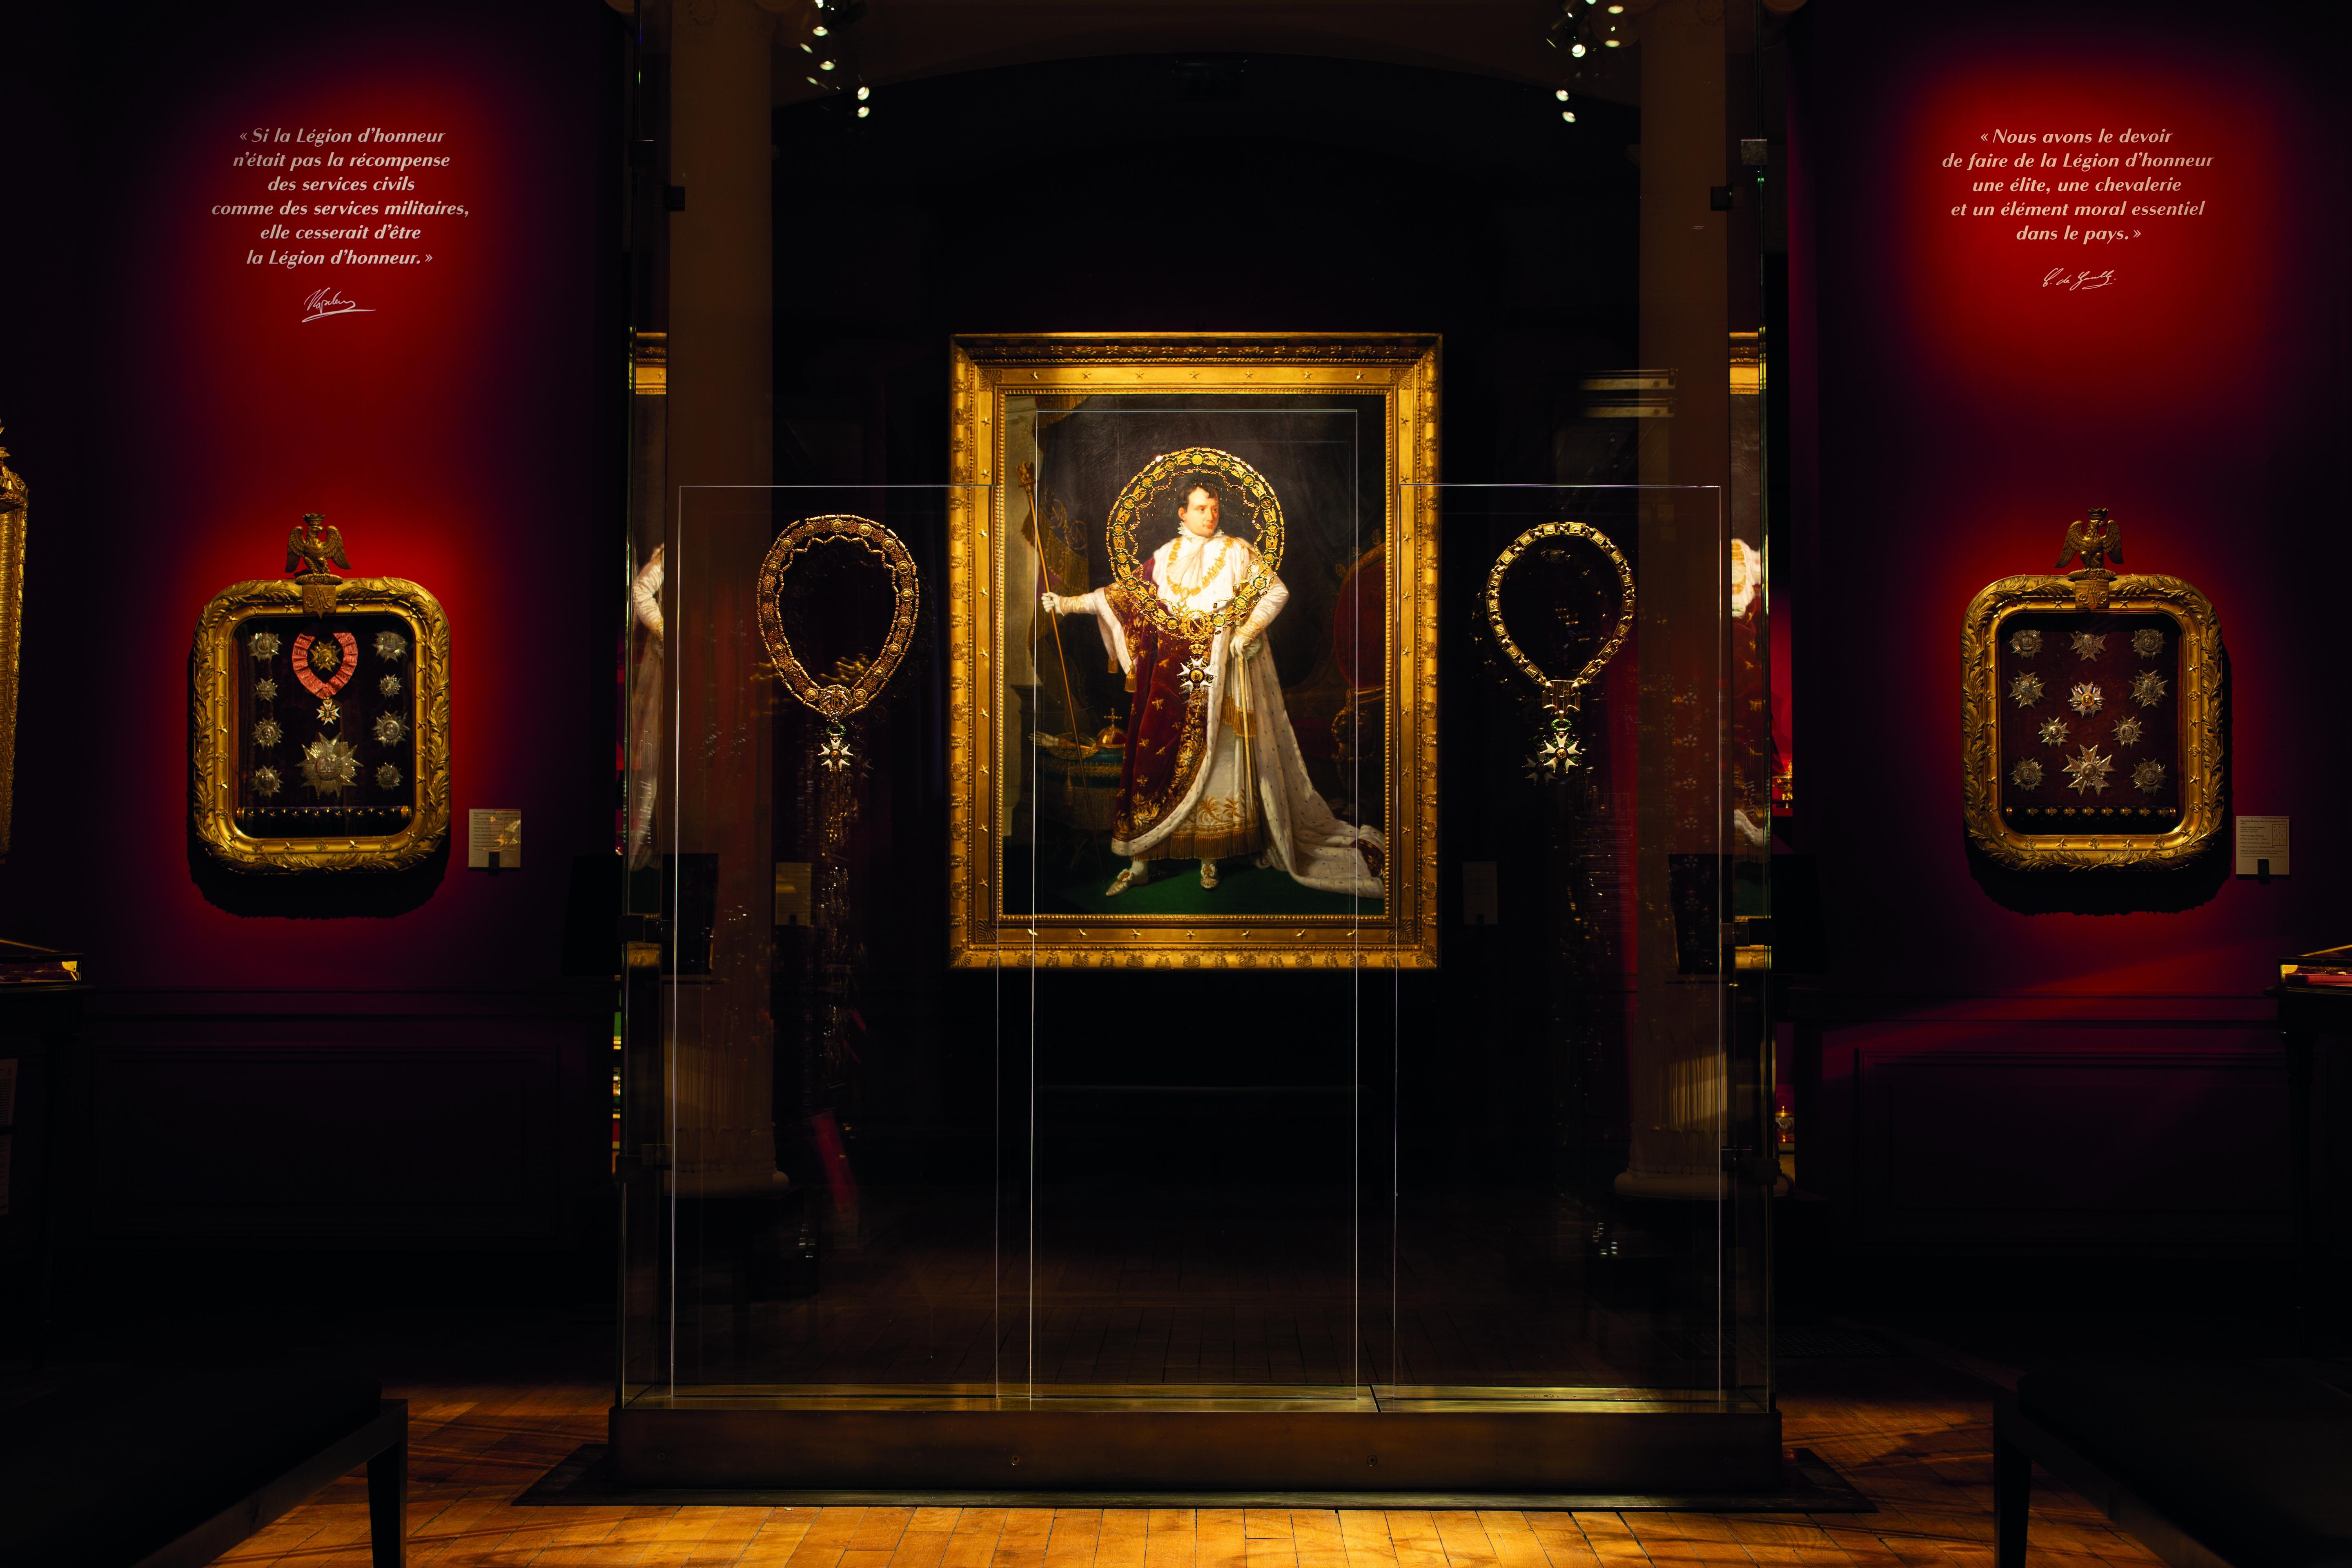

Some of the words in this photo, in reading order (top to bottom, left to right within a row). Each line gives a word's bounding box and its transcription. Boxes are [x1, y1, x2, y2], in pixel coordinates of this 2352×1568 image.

[252, 128, 270, 142] Si
[274, 128, 290, 142] la
[297, 129, 352, 147] Légion
[358, 127, 445, 142] d’honneur
[1993, 129, 2036, 143] Nous
[2043, 134, 2092, 143] avons
[2098, 129, 2113, 143] le
[2119, 128, 2173, 143] devoir
[233, 152, 286, 166] n’était
[290, 157, 321, 171] pas
[327, 152, 344, 167] la
[350, 153, 450, 171] récompense
[1942, 153, 1962, 167] de
[1967, 153, 2008, 170] faire
[2014, 153, 2034, 167] de
[2040, 153, 2057, 167] la
[2063, 153, 2119, 172] Légion
[2125, 152, 2214, 167] d’honneur
[268, 176, 296, 191] des
[302, 177, 367, 191] services
[373, 176, 414, 191] civils
[1973, 182, 2004, 192] une
[2010, 177, 2050, 194] élite,
[2058, 182, 2089, 192] une
[2095, 177, 2181, 191] chevalerie
[212, 205, 273, 215] comme
[280, 200, 307, 215] des
[314, 201, 379, 215] services
[385, 200, 468, 217] militaires,
[1951, 204, 1967, 216] et
[1973, 207, 1994, 216] un
[2001, 201, 2069, 216] élément
[2074, 201, 2127, 216] moral
[2132, 201, 2205, 215] essentiel
[261, 225, 290, 239] elle
[296, 225, 369, 239] cesserait
[374, 224, 421, 239] d’être
[2016, 225, 2057, 240] dans
[2064, 225, 2078, 240] le
[2083, 230, 2128, 245] pays.
[247, 250, 263, 264] la
[269, 250, 325, 269] Légion
[331, 249, 420, 264] d’honneur.
